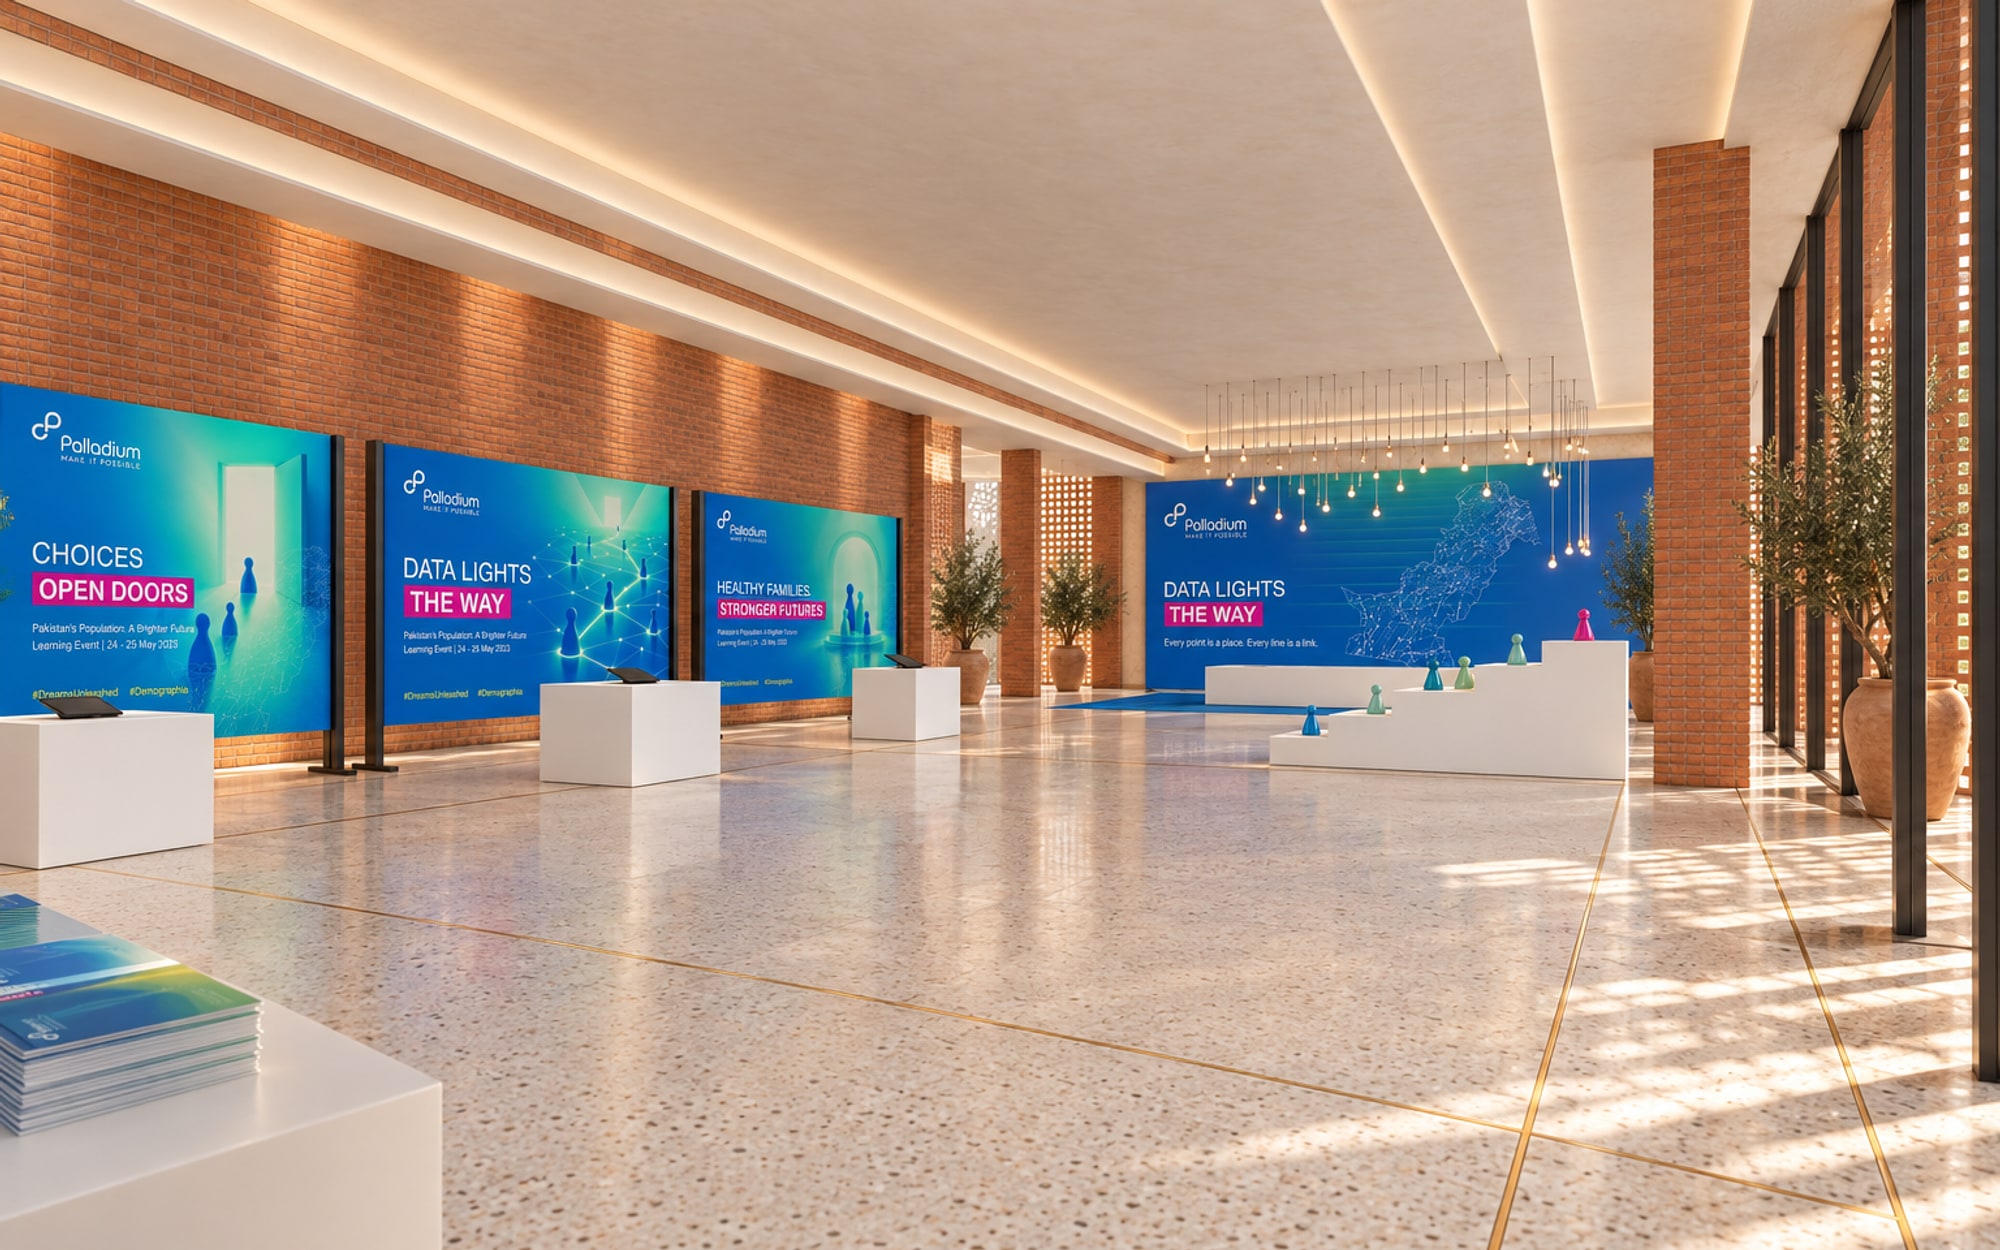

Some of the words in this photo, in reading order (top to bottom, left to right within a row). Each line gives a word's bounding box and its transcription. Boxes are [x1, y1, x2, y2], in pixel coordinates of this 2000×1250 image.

[61, 434, 141, 460] Palladium
[423, 488, 480, 508] Palladium
[1184, 518, 1247, 532] Palladium
[32, 541, 143, 569] CHOICES
[404, 557, 456, 580] DATA
[462, 560, 532, 584] LIGHTS
[39, 578, 104, 601] OPEN
[112, 580, 189, 603] DOORS
[717, 580, 765, 596] HEALTHY
[1164, 581, 1210, 598] DATA
[1216, 580, 1286, 598] LIGHTS
[410, 590, 454, 613] THE
[460, 592, 504, 614] WAY
[720, 602, 777, 616] STRONGER
[780, 604, 823, 616] FUTURES
[1169, 606, 1207, 622] THE
[1212, 606, 1256, 622] WAY
[128, 624, 135, 633] A
[32, 640, 72, 652] Learning
[74, 640, 100, 650] Event
[106, 640, 118, 650] 24
[139, 640, 156, 651] May
[1164, 638, 1184, 648] Every
[1186, 638, 1206, 648] point
[1207, 638, 1214, 646] is
[1246, 638, 1268, 648] Every
[1270, 638, 1286, 646] line
[1286, 638, 1294, 646] is
